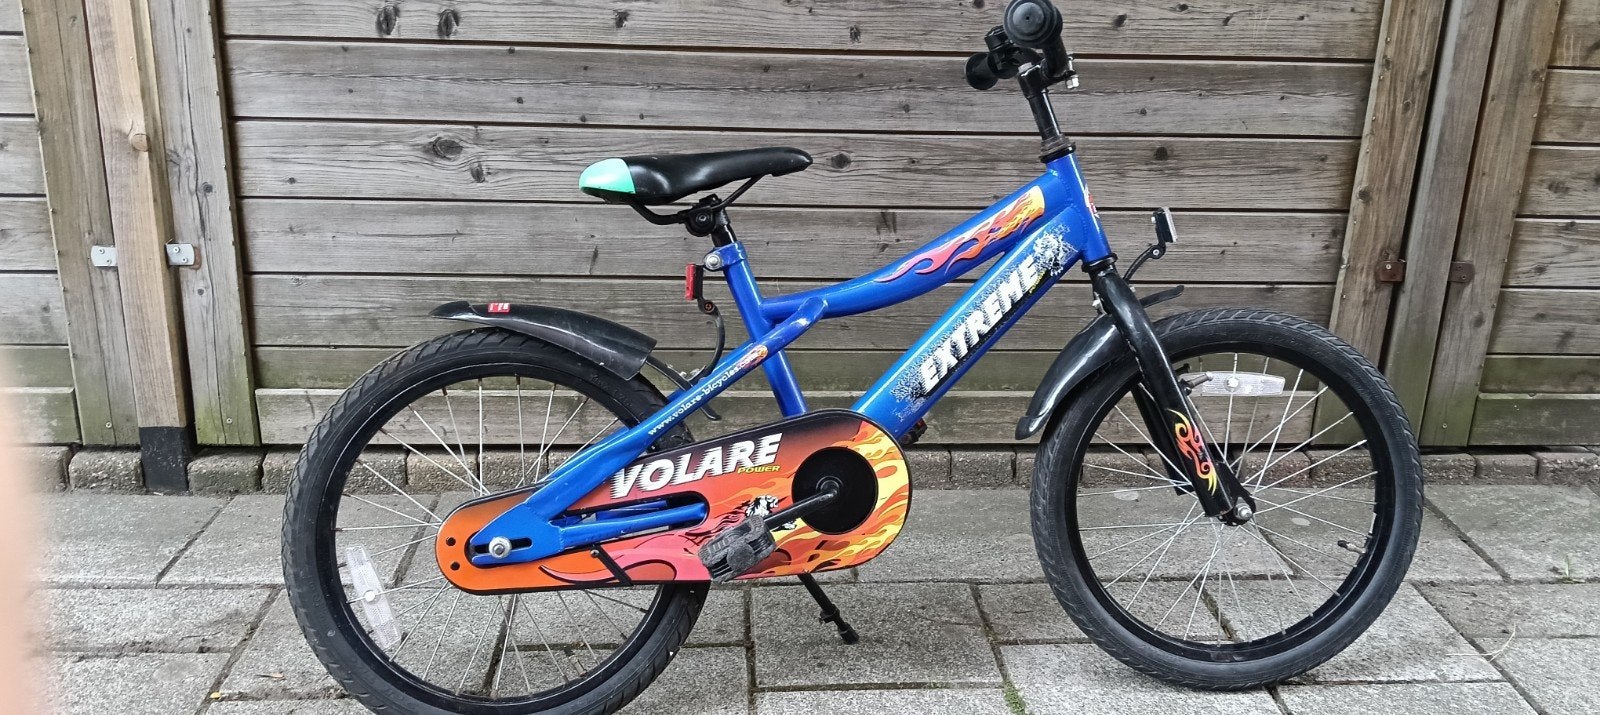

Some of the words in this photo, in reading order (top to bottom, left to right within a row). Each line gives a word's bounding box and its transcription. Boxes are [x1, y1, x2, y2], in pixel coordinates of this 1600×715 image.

[919, 255, 1038, 394] EXTREME
[609, 433, 783, 499] VOLARE
[737, 465, 780, 474] POWER
